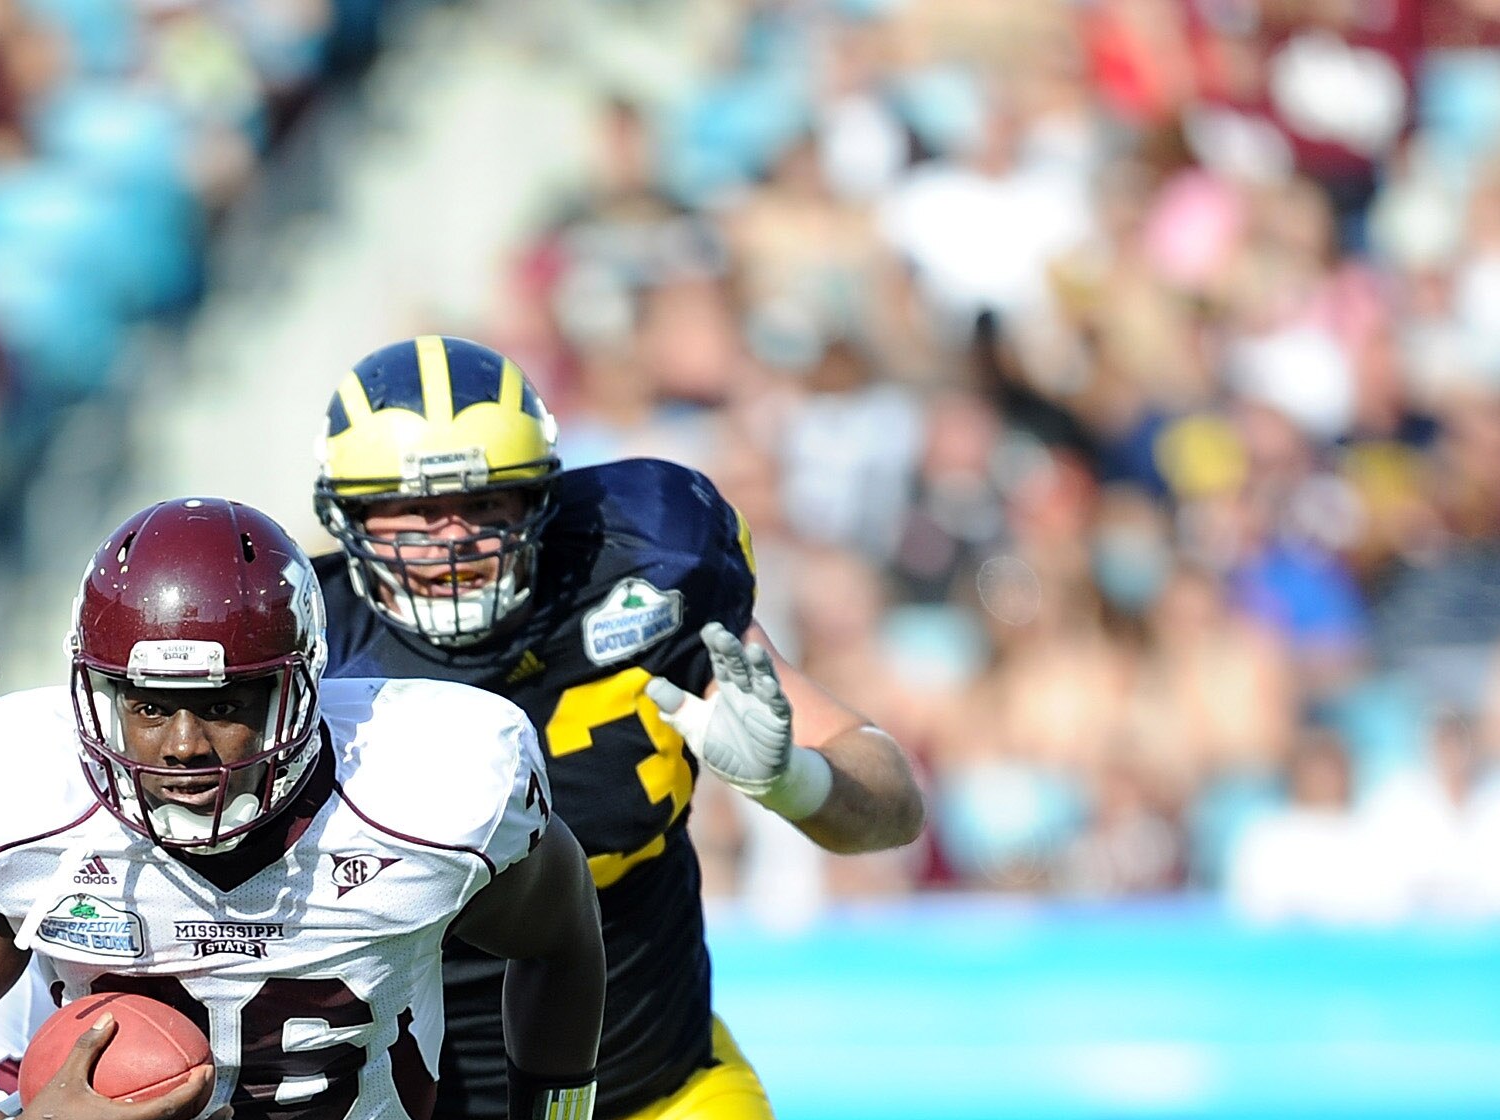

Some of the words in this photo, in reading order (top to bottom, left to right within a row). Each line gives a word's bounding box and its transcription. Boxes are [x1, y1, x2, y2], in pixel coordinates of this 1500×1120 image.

[72, 874, 118, 885] adidas
[342, 859, 369, 885] SEC
[174, 924, 284, 938] MISSISSIPPI
[91, 934, 140, 952] BOWL
[205, 941, 256, 956] STATE
